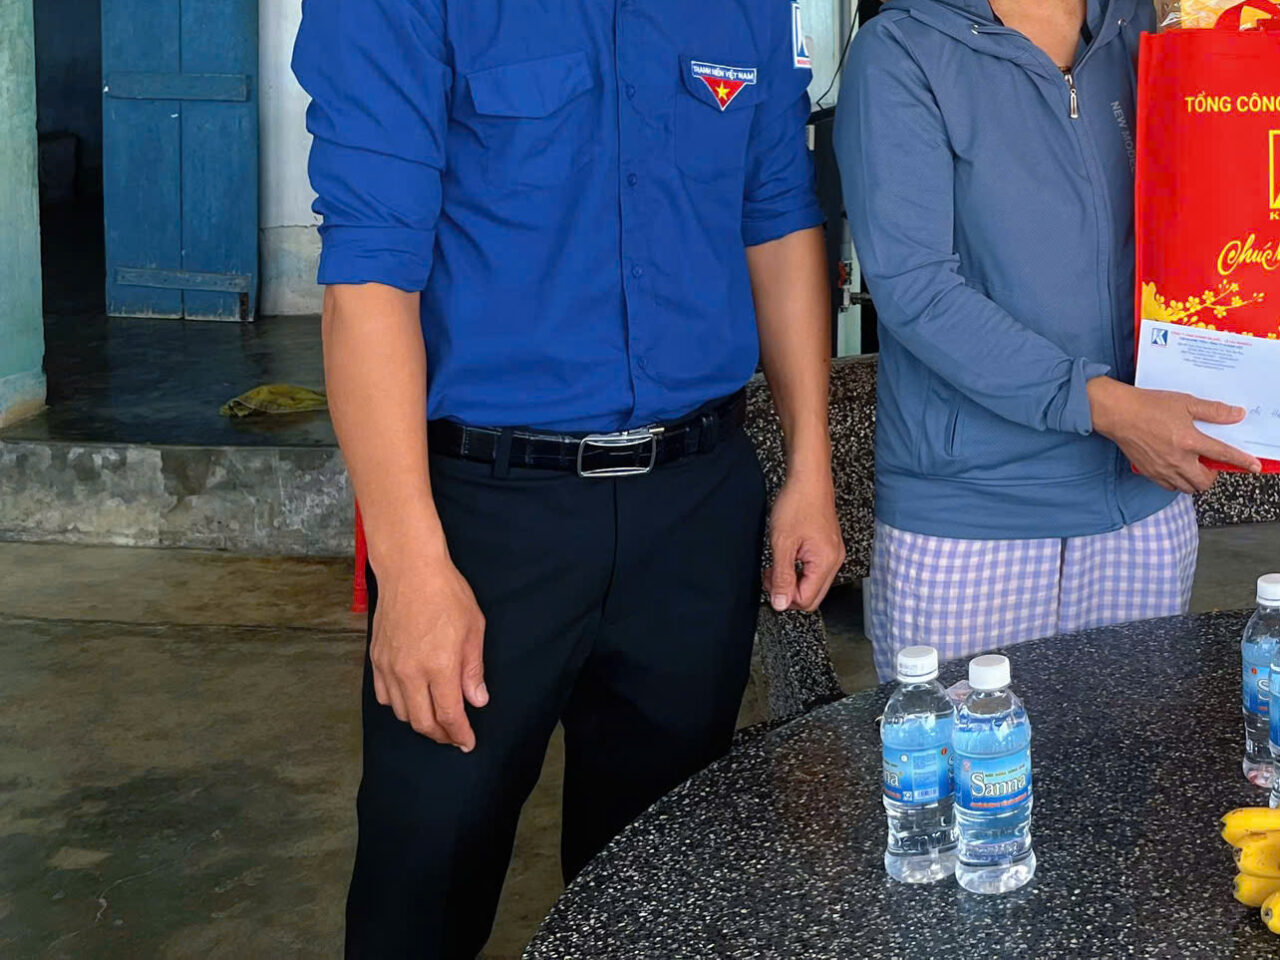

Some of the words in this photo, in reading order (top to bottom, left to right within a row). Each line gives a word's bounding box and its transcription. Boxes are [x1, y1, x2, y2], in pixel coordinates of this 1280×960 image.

[1110, 100, 1128, 129] NEW
[1184, 90, 1232, 113] TỔNG
[1217, 233, 1280, 276] Chúc
[970, 772, 1027, 798] Sanna
